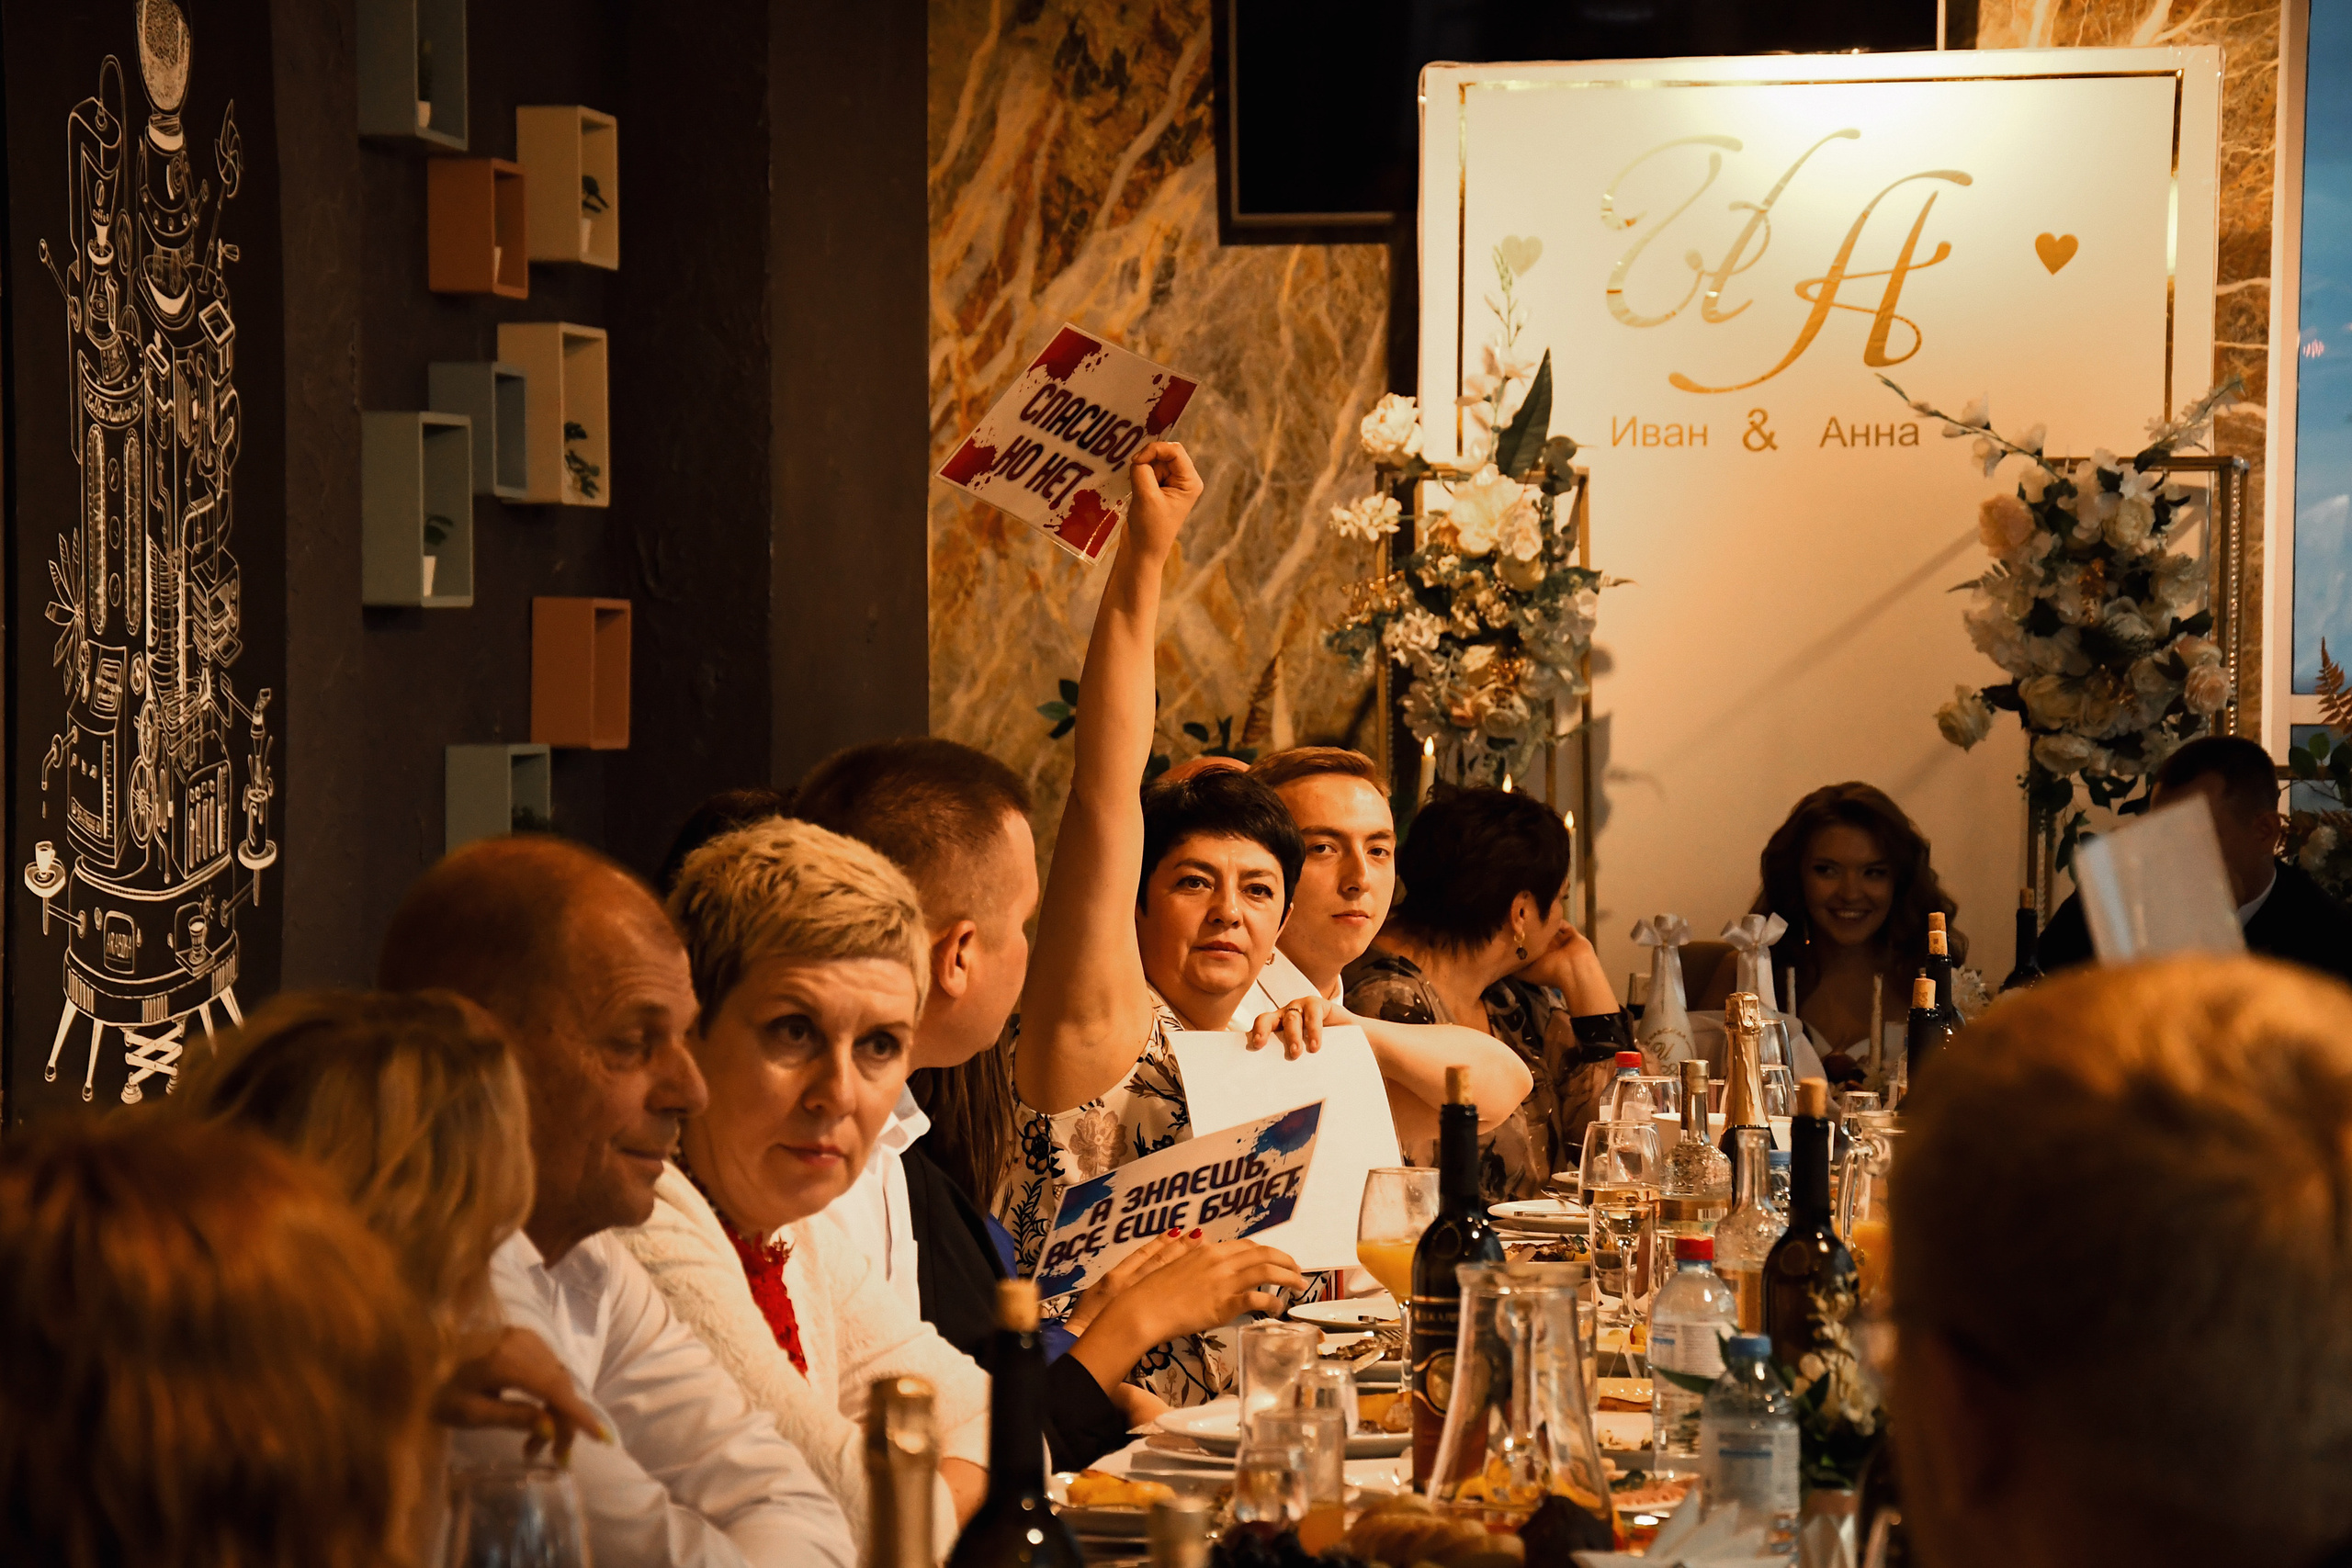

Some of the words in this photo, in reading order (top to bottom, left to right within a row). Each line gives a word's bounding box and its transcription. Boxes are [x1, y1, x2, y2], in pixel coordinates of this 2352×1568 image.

[1020, 383, 1145, 472] СПАСИБО,
[1611, 415, 1708, 447] Иван
[1742, 407, 1779, 453] &
[1819, 415, 1920, 448] Анна
[990, 434, 1044, 481] НО
[1024, 452, 1094, 511] НЕТ
[1044, 1224, 1107, 1269] ВСЕ
[1198, 1165, 1304, 1225] БУДЕТ
[1088, 1197, 1114, 1227] А
[1121, 1152, 1271, 1213] ЗНАЕШЬ,
